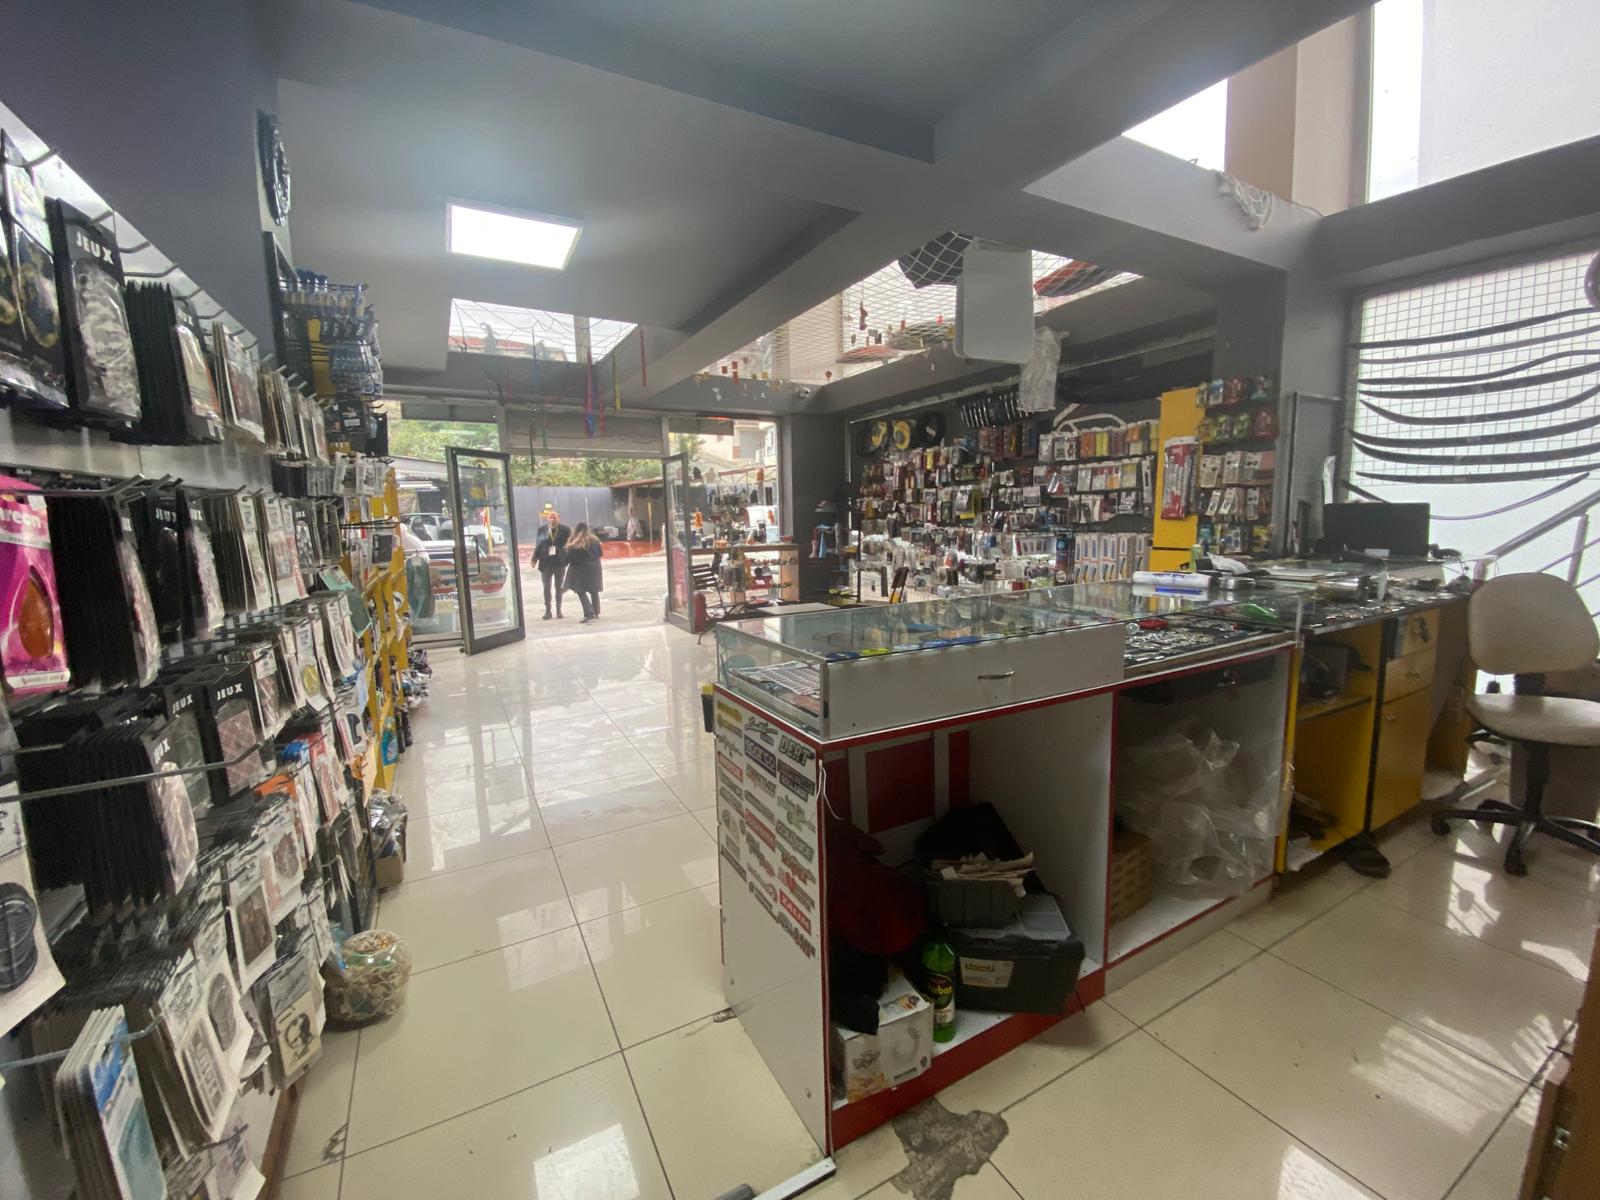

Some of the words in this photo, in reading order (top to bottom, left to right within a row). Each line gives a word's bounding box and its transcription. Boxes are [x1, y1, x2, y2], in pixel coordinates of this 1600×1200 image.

[76, 231, 114, 265] JEUX
[216, 682, 243, 701] JEUX
[172, 693, 193, 714] JEUX
